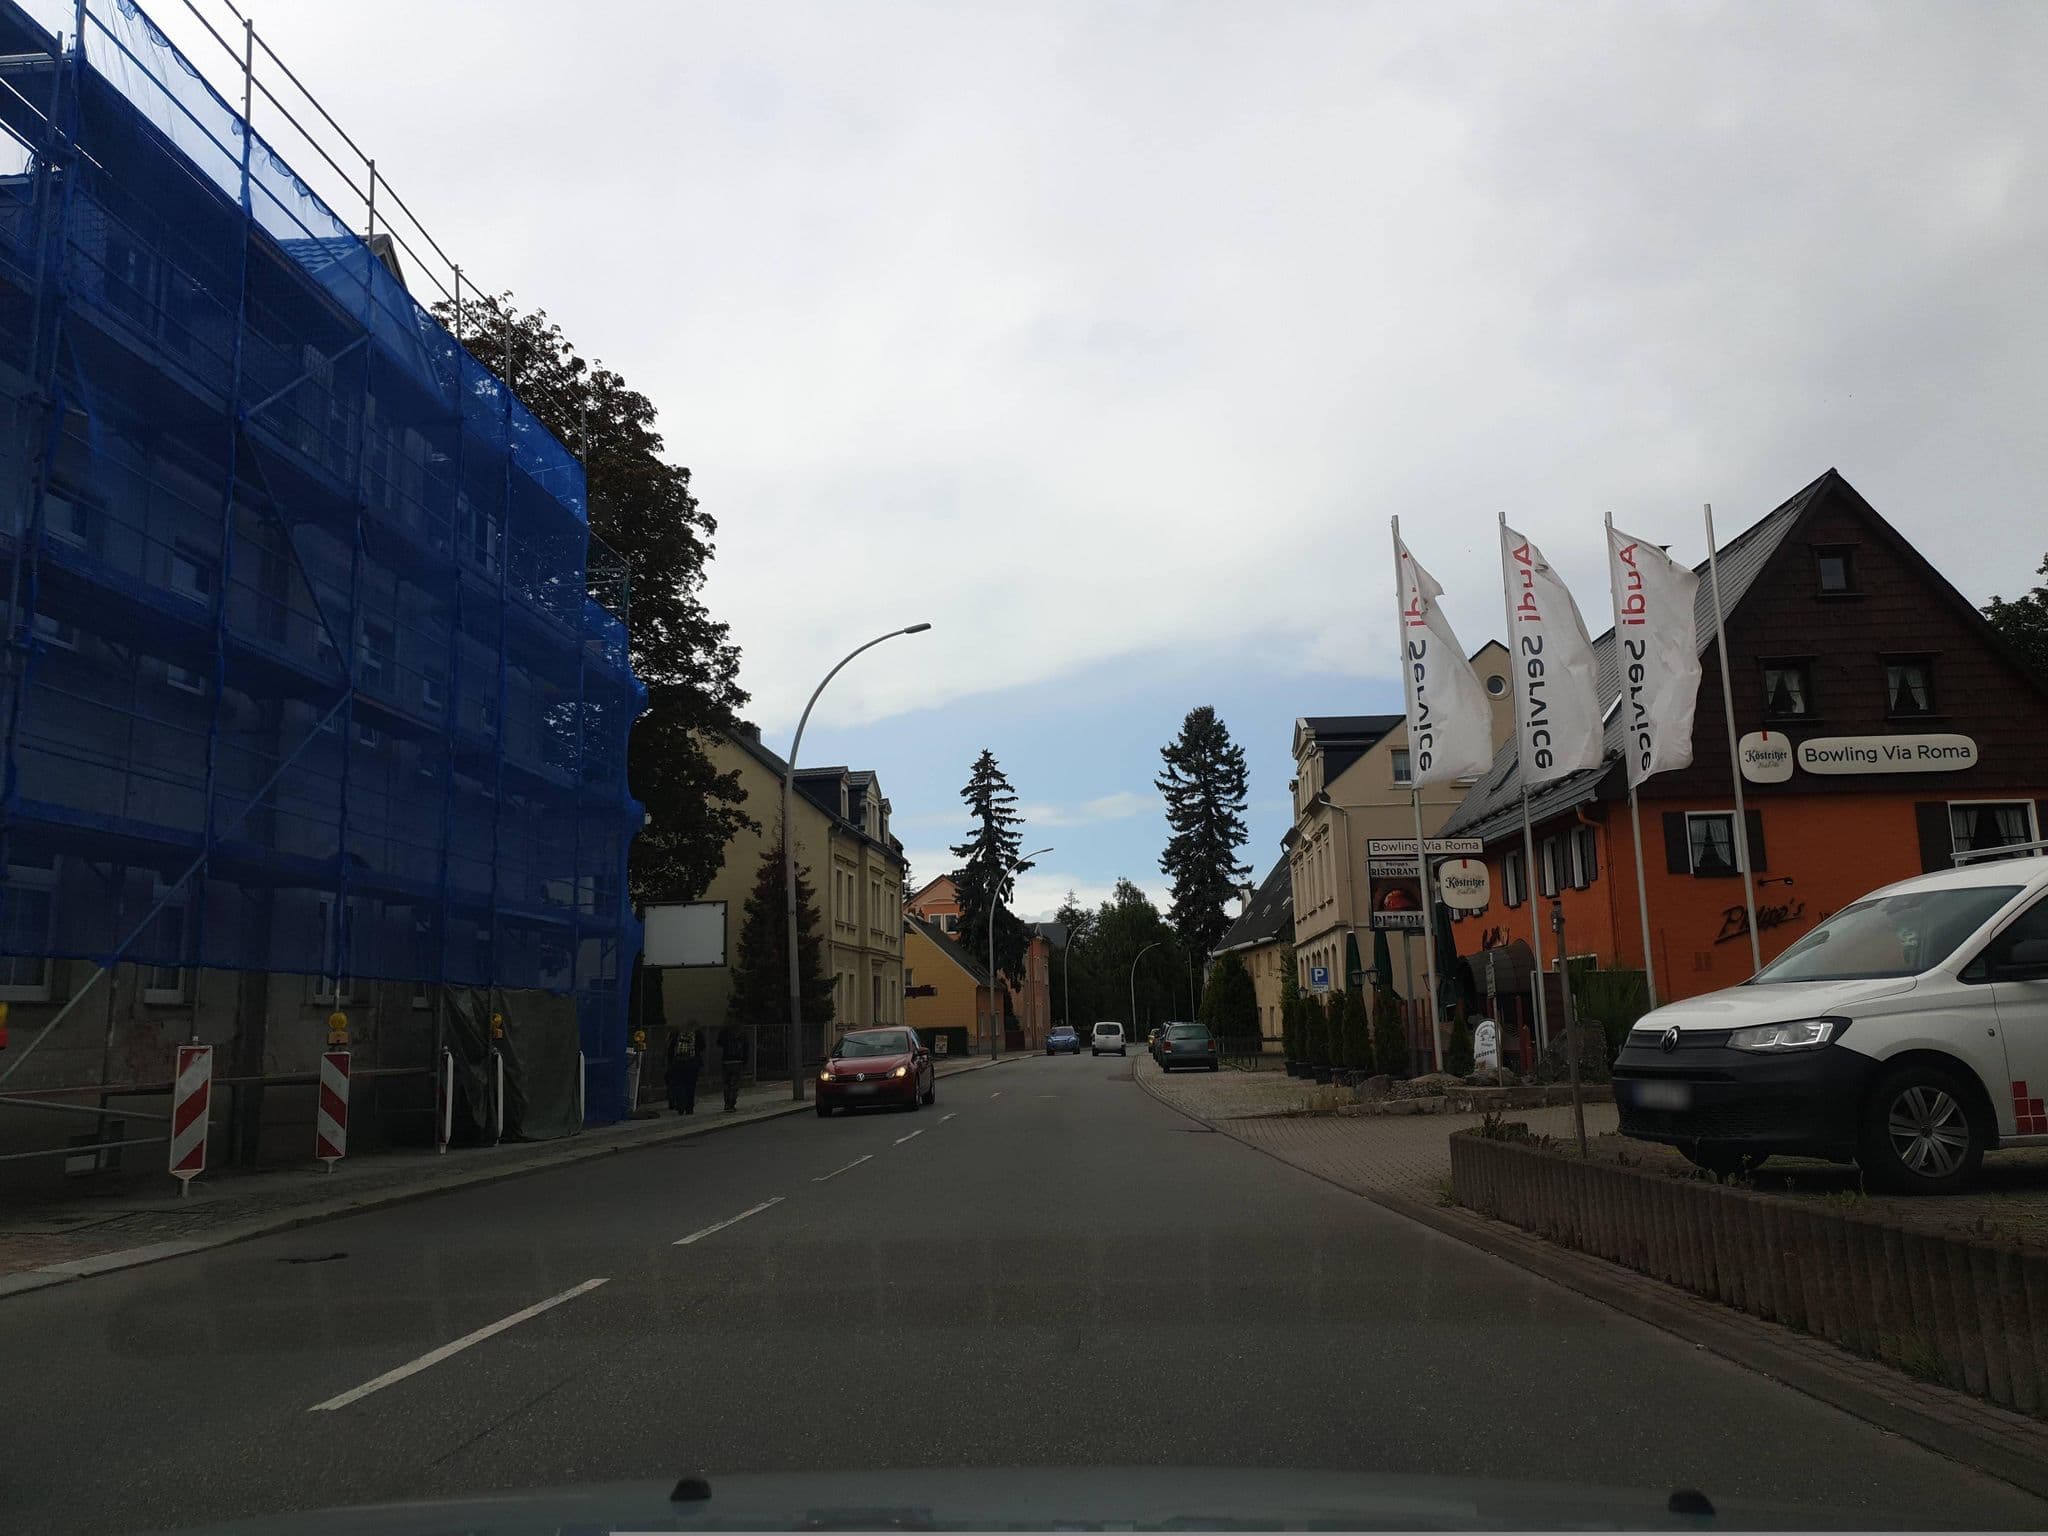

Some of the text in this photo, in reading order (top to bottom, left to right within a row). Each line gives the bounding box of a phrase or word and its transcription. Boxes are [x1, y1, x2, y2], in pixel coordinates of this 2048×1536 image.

[1805, 744, 1971, 763] Bowling Via Roma
[1372, 840, 1479, 852] Bowling Via Roma
[1370, 867, 1420, 876] RISTORANT
[1314, 968, 1325, 982] P
